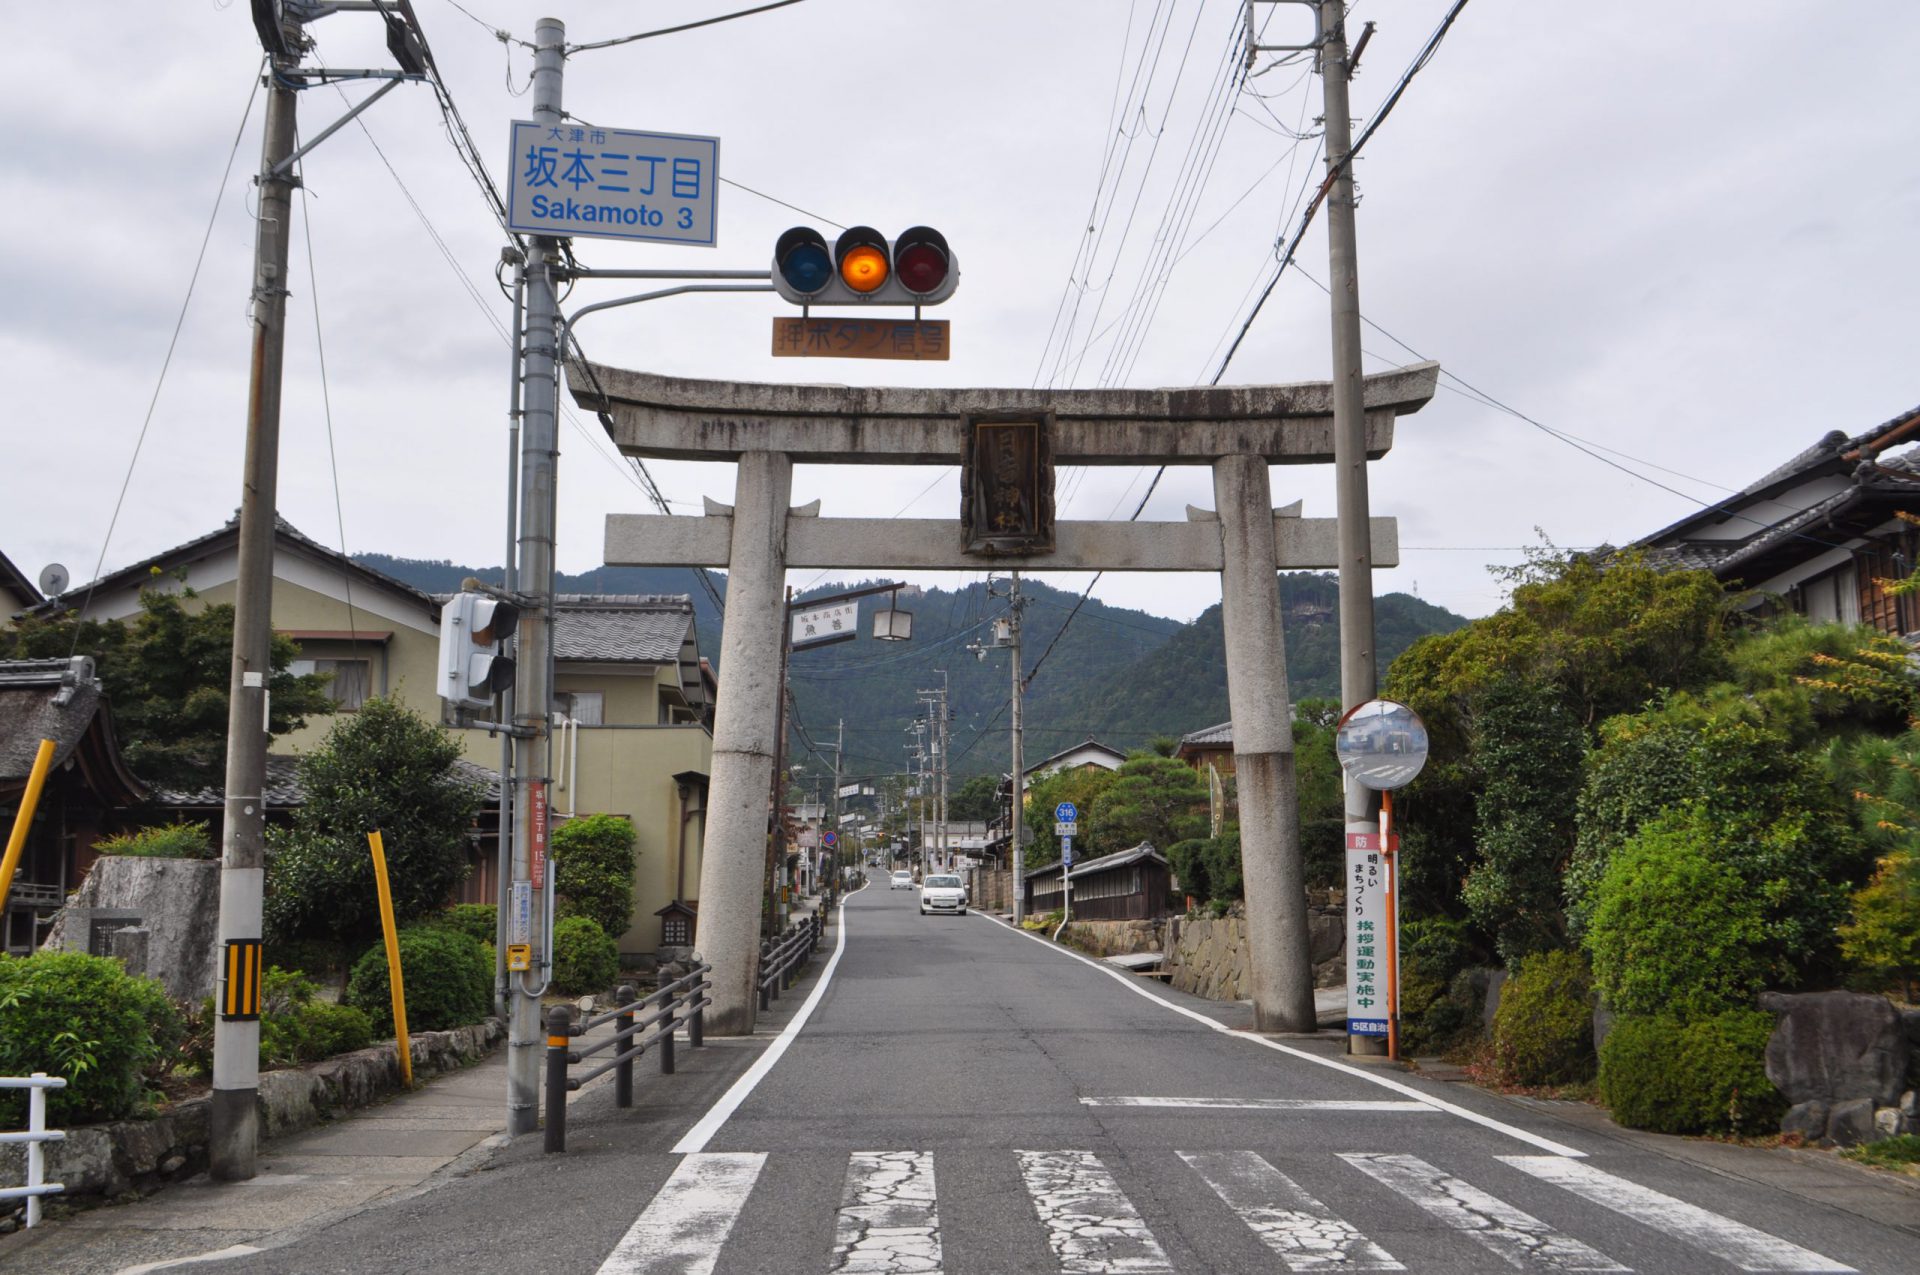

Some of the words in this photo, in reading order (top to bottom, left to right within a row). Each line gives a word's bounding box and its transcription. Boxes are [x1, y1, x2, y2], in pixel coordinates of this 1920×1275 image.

[547, 127, 606, 145] 大津市
[523, 144, 701, 199] 坂本三丁目
[531, 194, 664, 228] Sakamoto
[676, 206, 694, 230] 3
[777, 322, 944, 355] 押ボタン信号
[535, 790, 544, 843] 坂本三丁目
[1058, 808, 1074, 817] 316
[1367, 853, 1379, 888] 明るい
[1354, 864, 1365, 916] まちづくり
[1356, 920, 1375, 1009] 挨拶運動実施中
